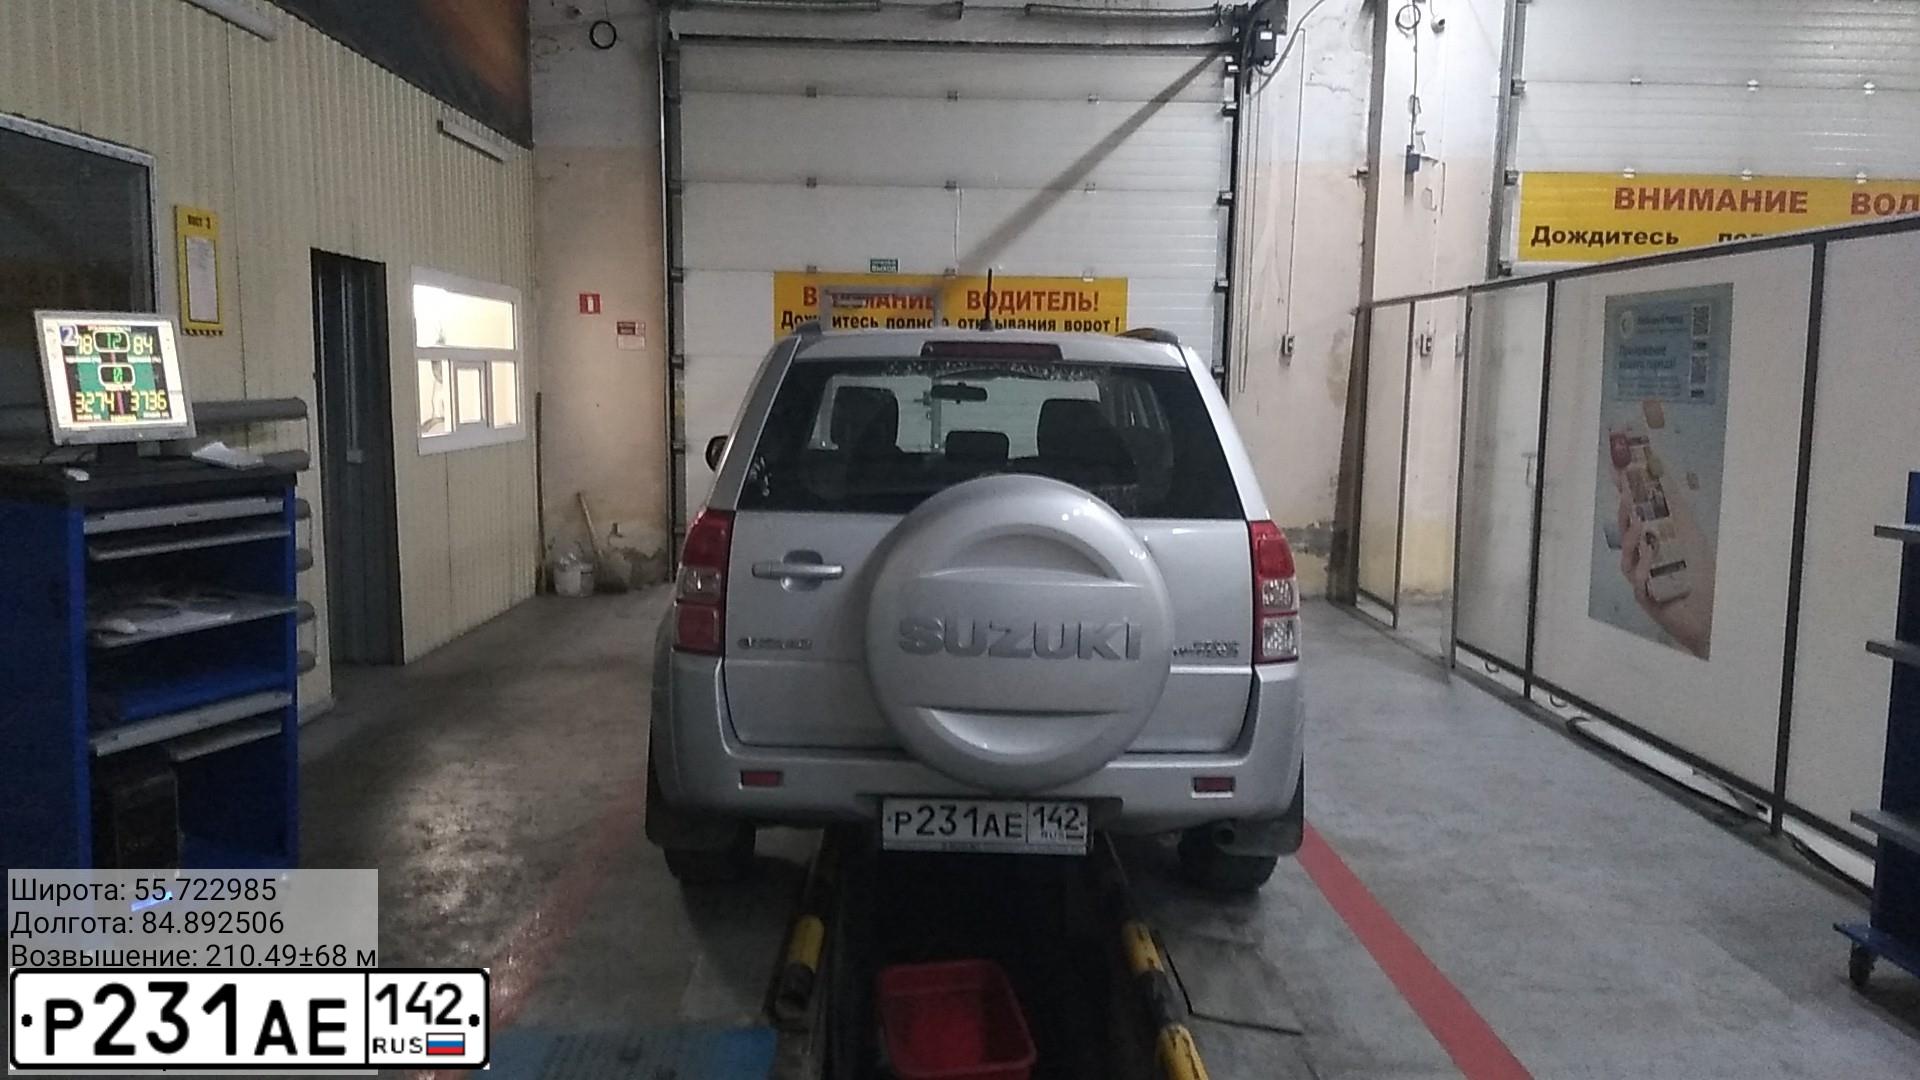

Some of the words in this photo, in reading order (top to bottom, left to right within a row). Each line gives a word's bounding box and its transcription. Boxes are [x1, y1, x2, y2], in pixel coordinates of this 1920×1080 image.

[1614, 186, 1809, 215] ВНИМАНИЕ
[1531, 225, 1680, 248] Дождитесь
[966, 290, 1099, 315] ВОДИТЕЛЬ!
[132, 335, 153, 355] 84
[75, 391, 115, 413] 3274
[898, 618, 1142, 660] SUZUKI
[1033, 806, 1080, 831] 142
